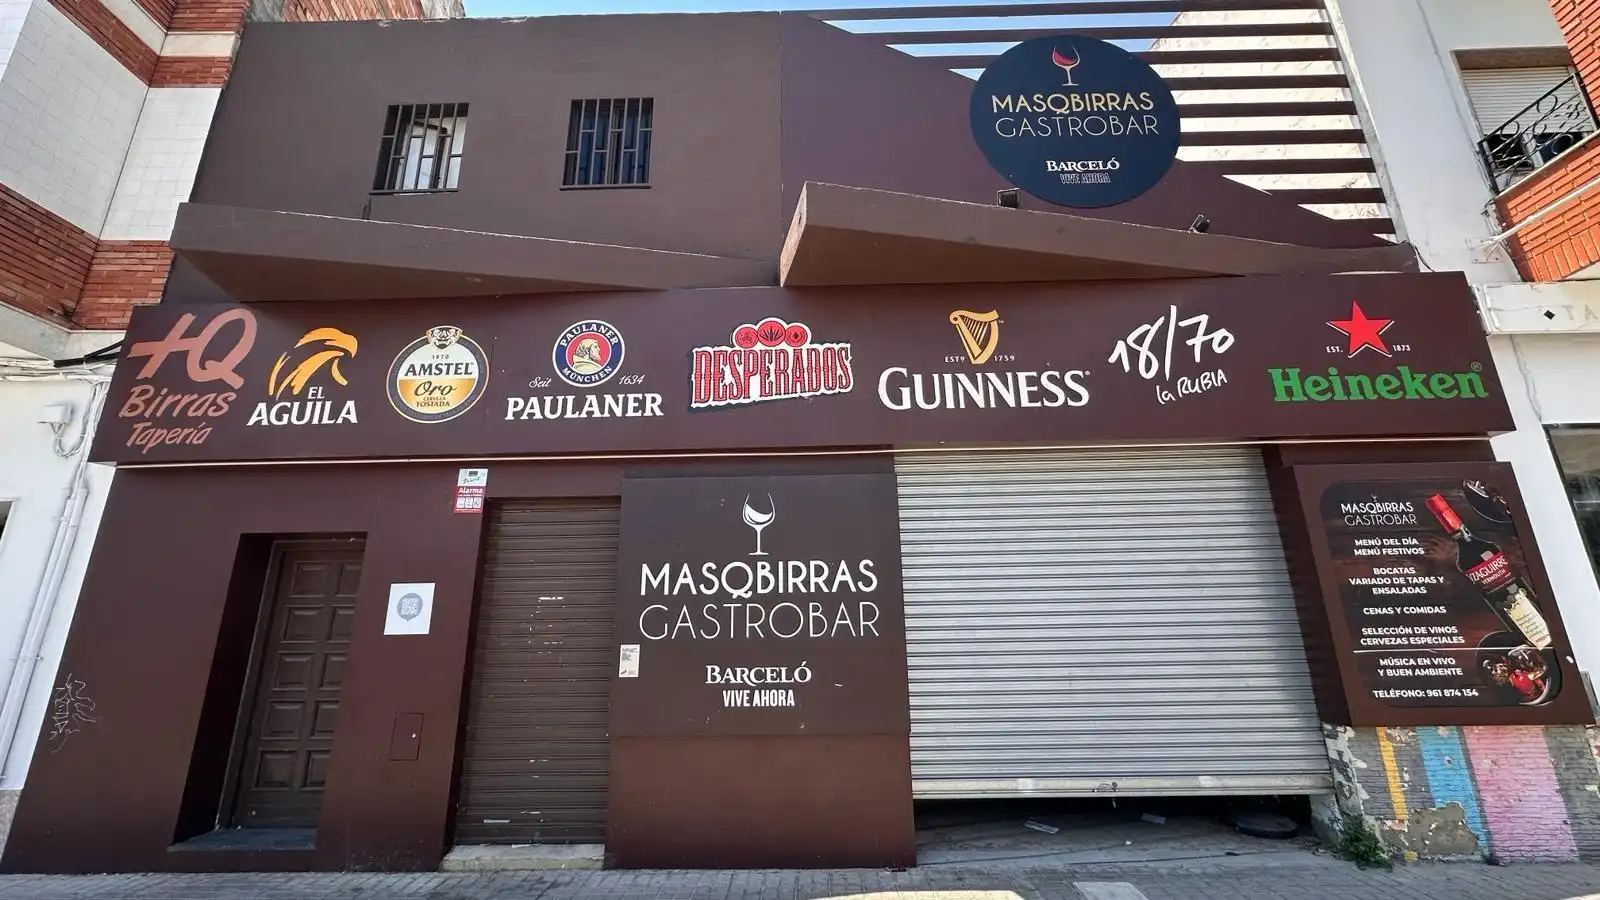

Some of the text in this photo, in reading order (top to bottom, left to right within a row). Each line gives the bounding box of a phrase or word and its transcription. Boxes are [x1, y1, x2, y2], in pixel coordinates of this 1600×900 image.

[992, 92, 1154, 114] MASQBIRRAS
[995, 115, 1159, 138] GASTROBAR
[1045, 157, 1120, 172] BARCELÓ
[1060, 172, 1111, 184] VIVE AHORA
[560, 323, 619, 347] PAULANER
[1107, 304, 1235, 381] 18/70
[1392, 344, 1411, 352] 1873
[994, 354, 1016, 362] 1759
[404, 362, 473, 377] AMSTEL
[692, 345, 852, 405] DESPERADOS
[529, 376, 551, 388] Seit
[618, 374, 646, 385] 1634
[1156, 368, 1228, 405] la RUBIA
[1267, 365, 1490, 402] Heineken
[307, 386, 323, 399] EL
[414, 380, 458, 397] Oro
[877, 366, 1090, 411] GUINNESS
[118, 384, 237, 418] Birras
[504, 392, 664, 421] PAULANER
[247, 400, 358, 426] AGUILA
[126, 422, 212, 454] Tapería
[1341, 501, 1414, 514] MASQBIRRAS
[1344, 513, 1417, 527] GASTROBAR
[1354, 537, 1381, 546] MENÚ
[1403, 536, 1419, 545] DÍA
[1354, 546, 1425, 556] MENÚ FESTIVOS
[1373, 567, 1416, 575] BOCATAS
[640, 559, 879, 599] MASQBIRRAS
[1349, 576, 1445, 586] VARIADO DE TAPAS Y
[1372, 586, 1427, 595] ENSALADAS
[1363, 605, 1447, 615] CENAS Y COMIDAS
[639, 601, 880, 640] GASTROBAR
[1362, 624, 1412, 635] SELECCIÓN
[1428, 625, 1458, 634] VINOS
[1360, 635, 1465, 645] CERVEZAS ESPECIALES
[1379, 656, 1456, 666] MÚSICA EN VIVO
[705, 661, 812, 686] BARCELÓ
[1377, 667, 1463, 677] Y BUEN AMBIENTE
[722, 689, 795, 707] VIVE AHORA
[1372, 688, 1479, 698] TELÉFONO: 961 874 154
